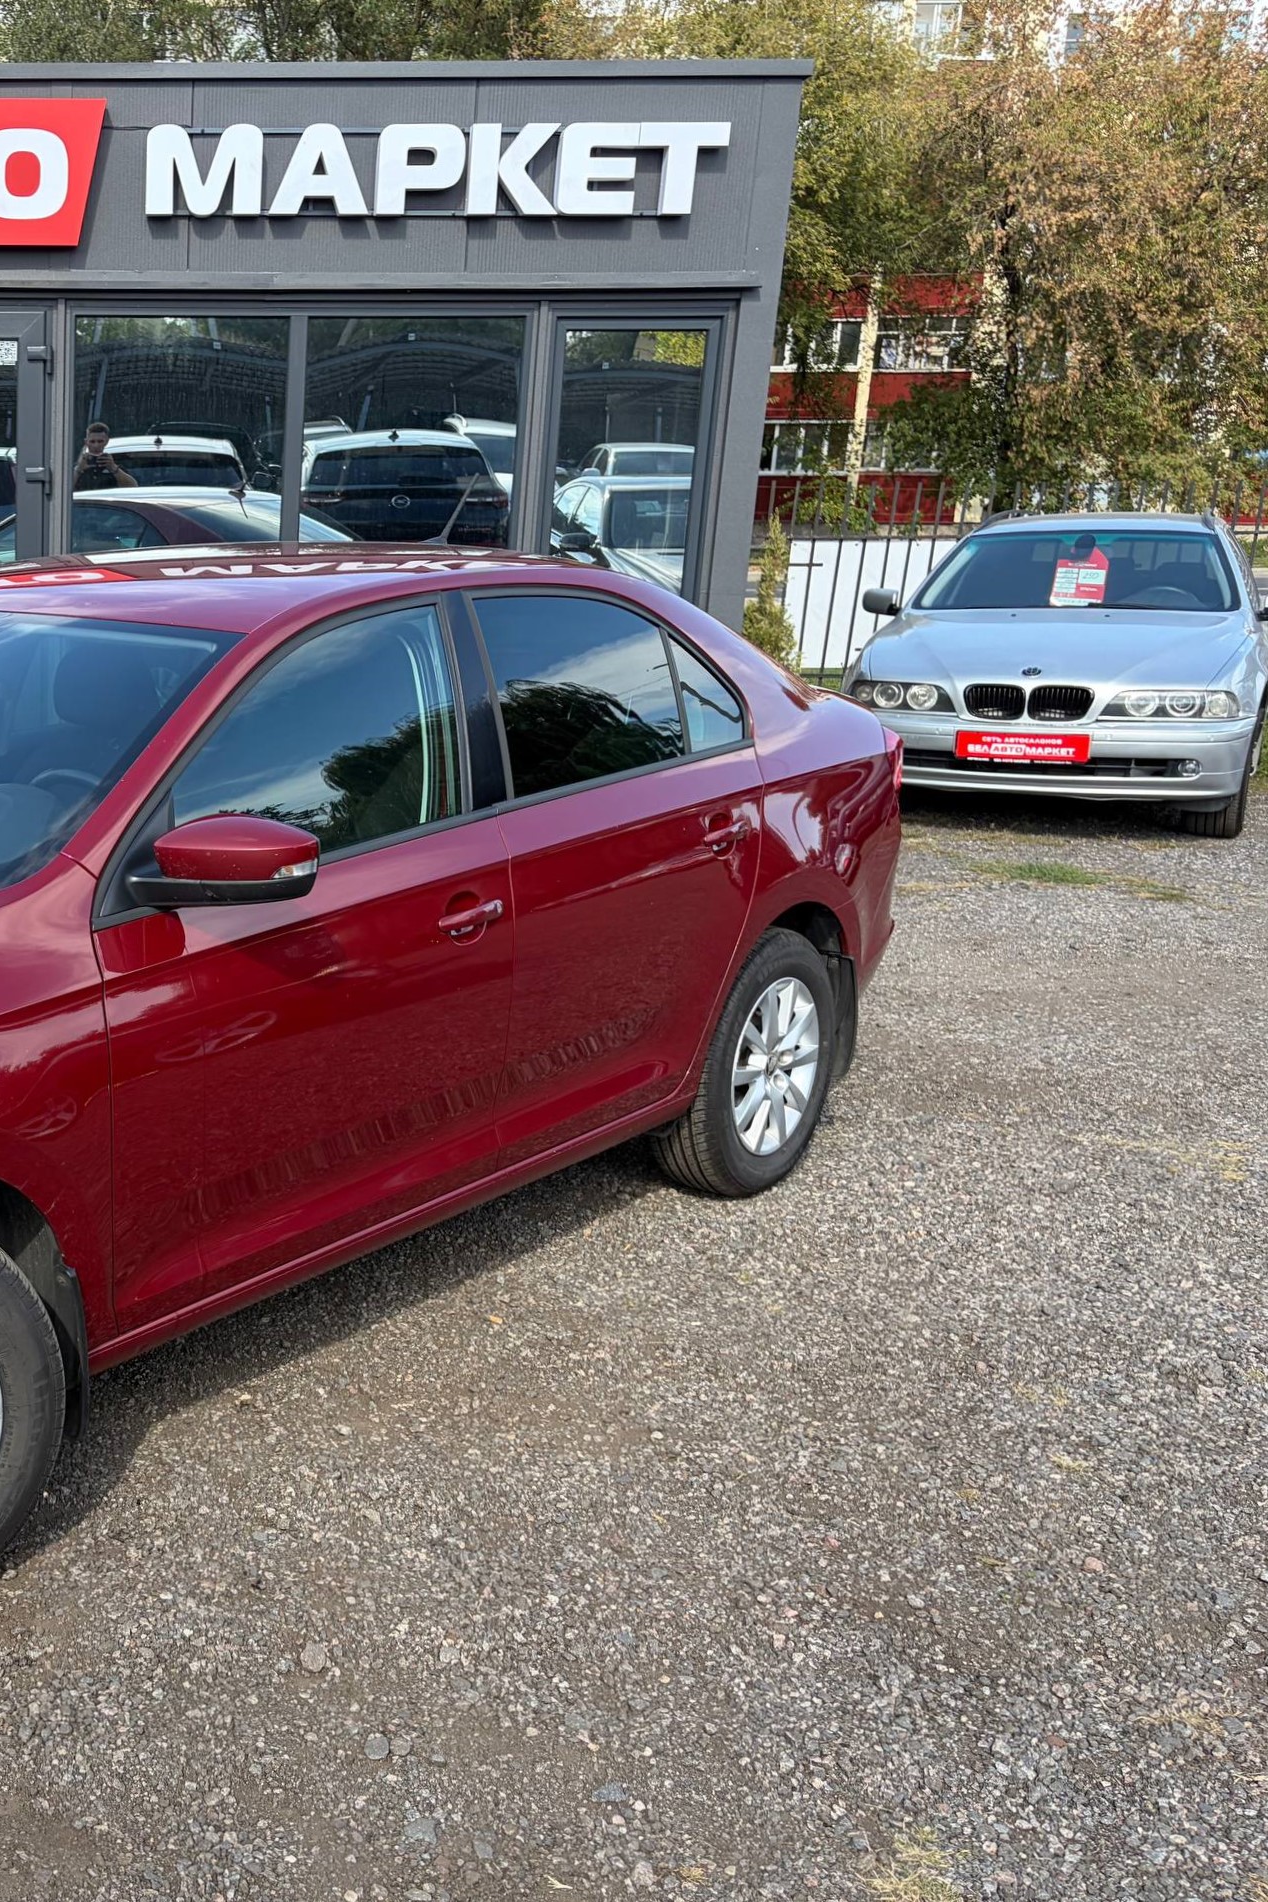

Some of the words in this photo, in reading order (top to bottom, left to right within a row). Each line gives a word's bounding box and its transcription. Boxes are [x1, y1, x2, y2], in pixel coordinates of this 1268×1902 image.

[145, 121, 732, 218] МАРКЕТ
[1004, 737, 1063, 745] АВТОСАЛОНОВ
[1025, 746, 1076, 757] МАРКЕТ
